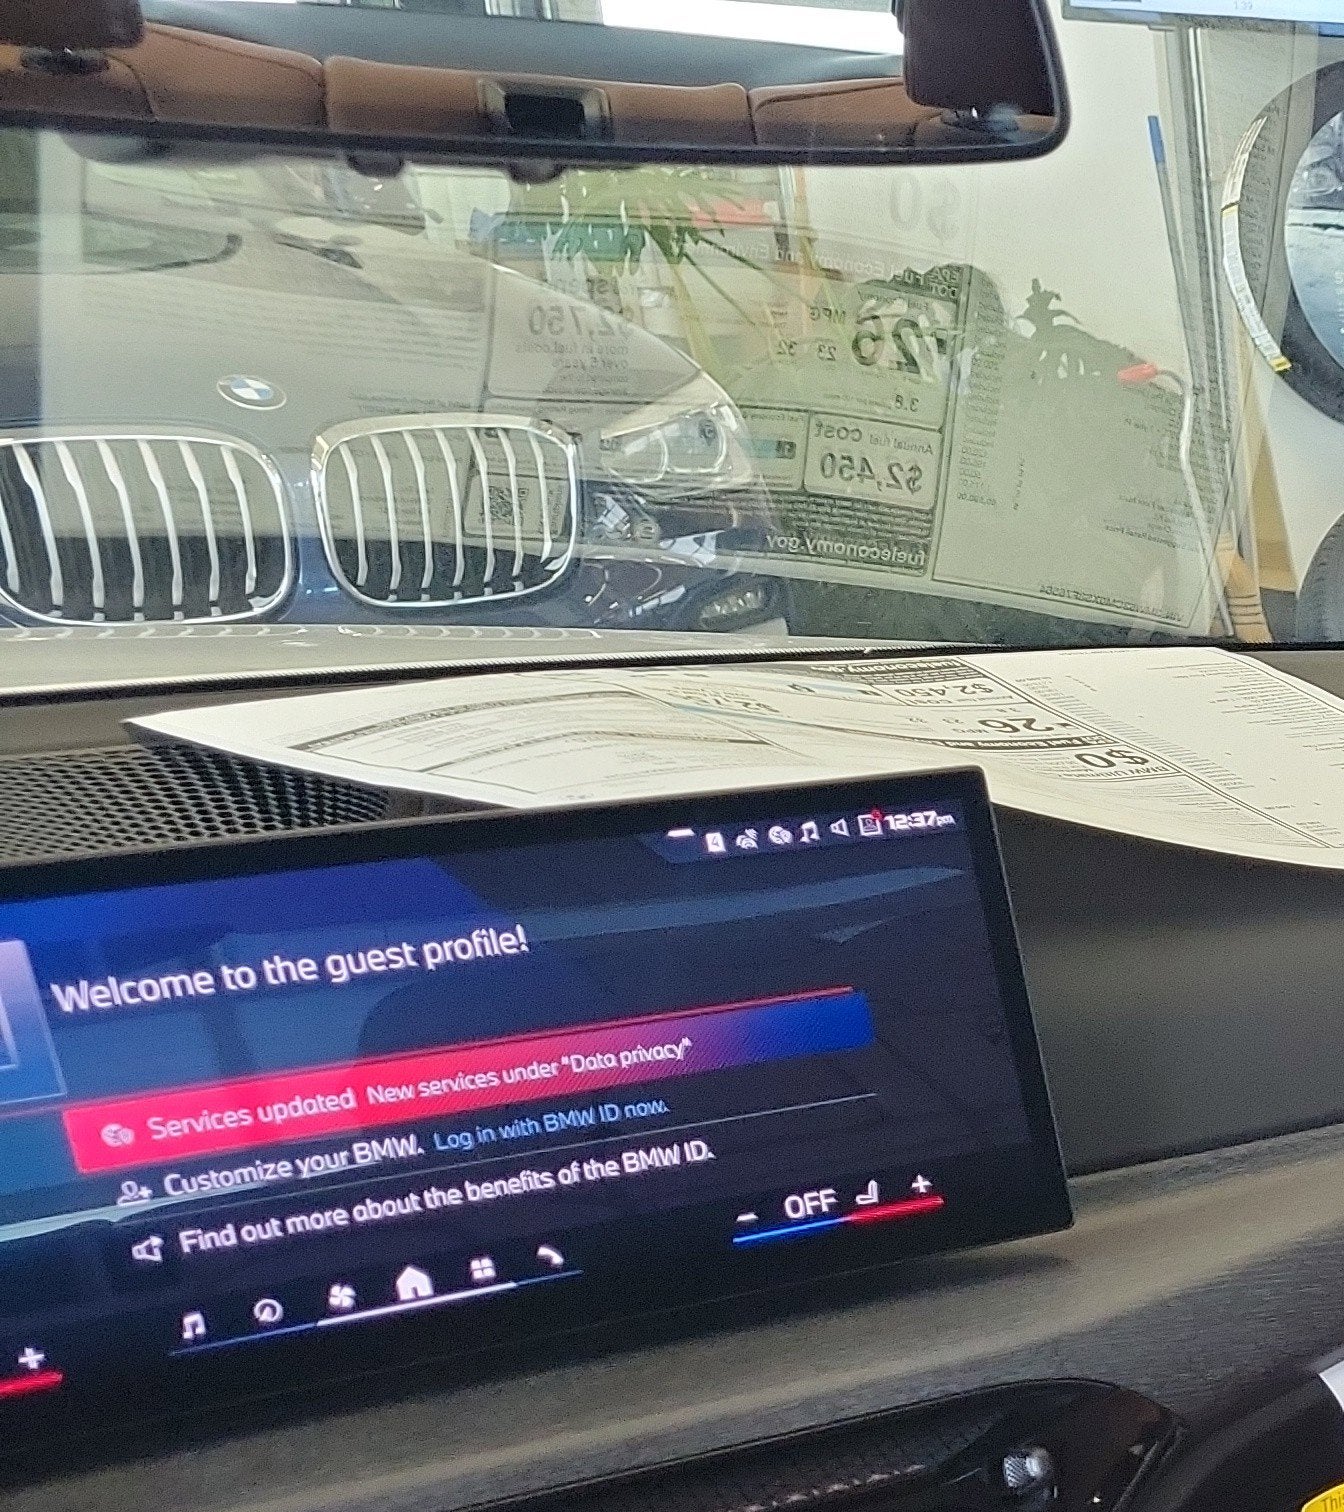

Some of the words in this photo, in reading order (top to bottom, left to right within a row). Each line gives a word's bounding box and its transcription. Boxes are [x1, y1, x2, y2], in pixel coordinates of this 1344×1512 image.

[894, 682, 994, 698] $2,450
[977, 717, 1055, 734] 26
[1074, 748, 1150, 769] $0
[50, 969, 217, 1014] Welcome
[220, 964, 258, 990] to
[262, 955, 319, 985] the
[324, 942, 419, 984] guest
[423, 922, 530, 971] profile!
[147, 1106, 253, 1140] Services
[257, 1087, 358, 1124] updated
[366, 1083, 415, 1105] New
[420, 1068, 501, 1097] services
[502, 1061, 560, 1085] under
[163, 1158, 295, 1197] Customize
[295, 1149, 351, 1180] your
[352, 1133, 425, 1164] BMW.
[434, 1130, 475, 1151] Log
[476, 1125, 496, 1144] in
[500, 1117, 541, 1140] with
[543, 1105, 597, 1134] BMW
[599, 1103, 621, 1124] ID
[625, 1099, 671, 1117] now.
[179, 1223, 238, 1253] Find
[240, 1218, 285, 1243] out
[286, 1209, 350, 1236] more
[353, 1192, 423, 1222] about
[424, 1184, 464, 1209] the
[465, 1168, 556, 1202] benefits
[558, 1163, 583, 1185] of
[584, 1157, 621, 1181] the
[622, 1144, 681, 1174] BMW
[685, 1139, 717, 1162] ID.
[784, 1187, 839, 1219] OFF
